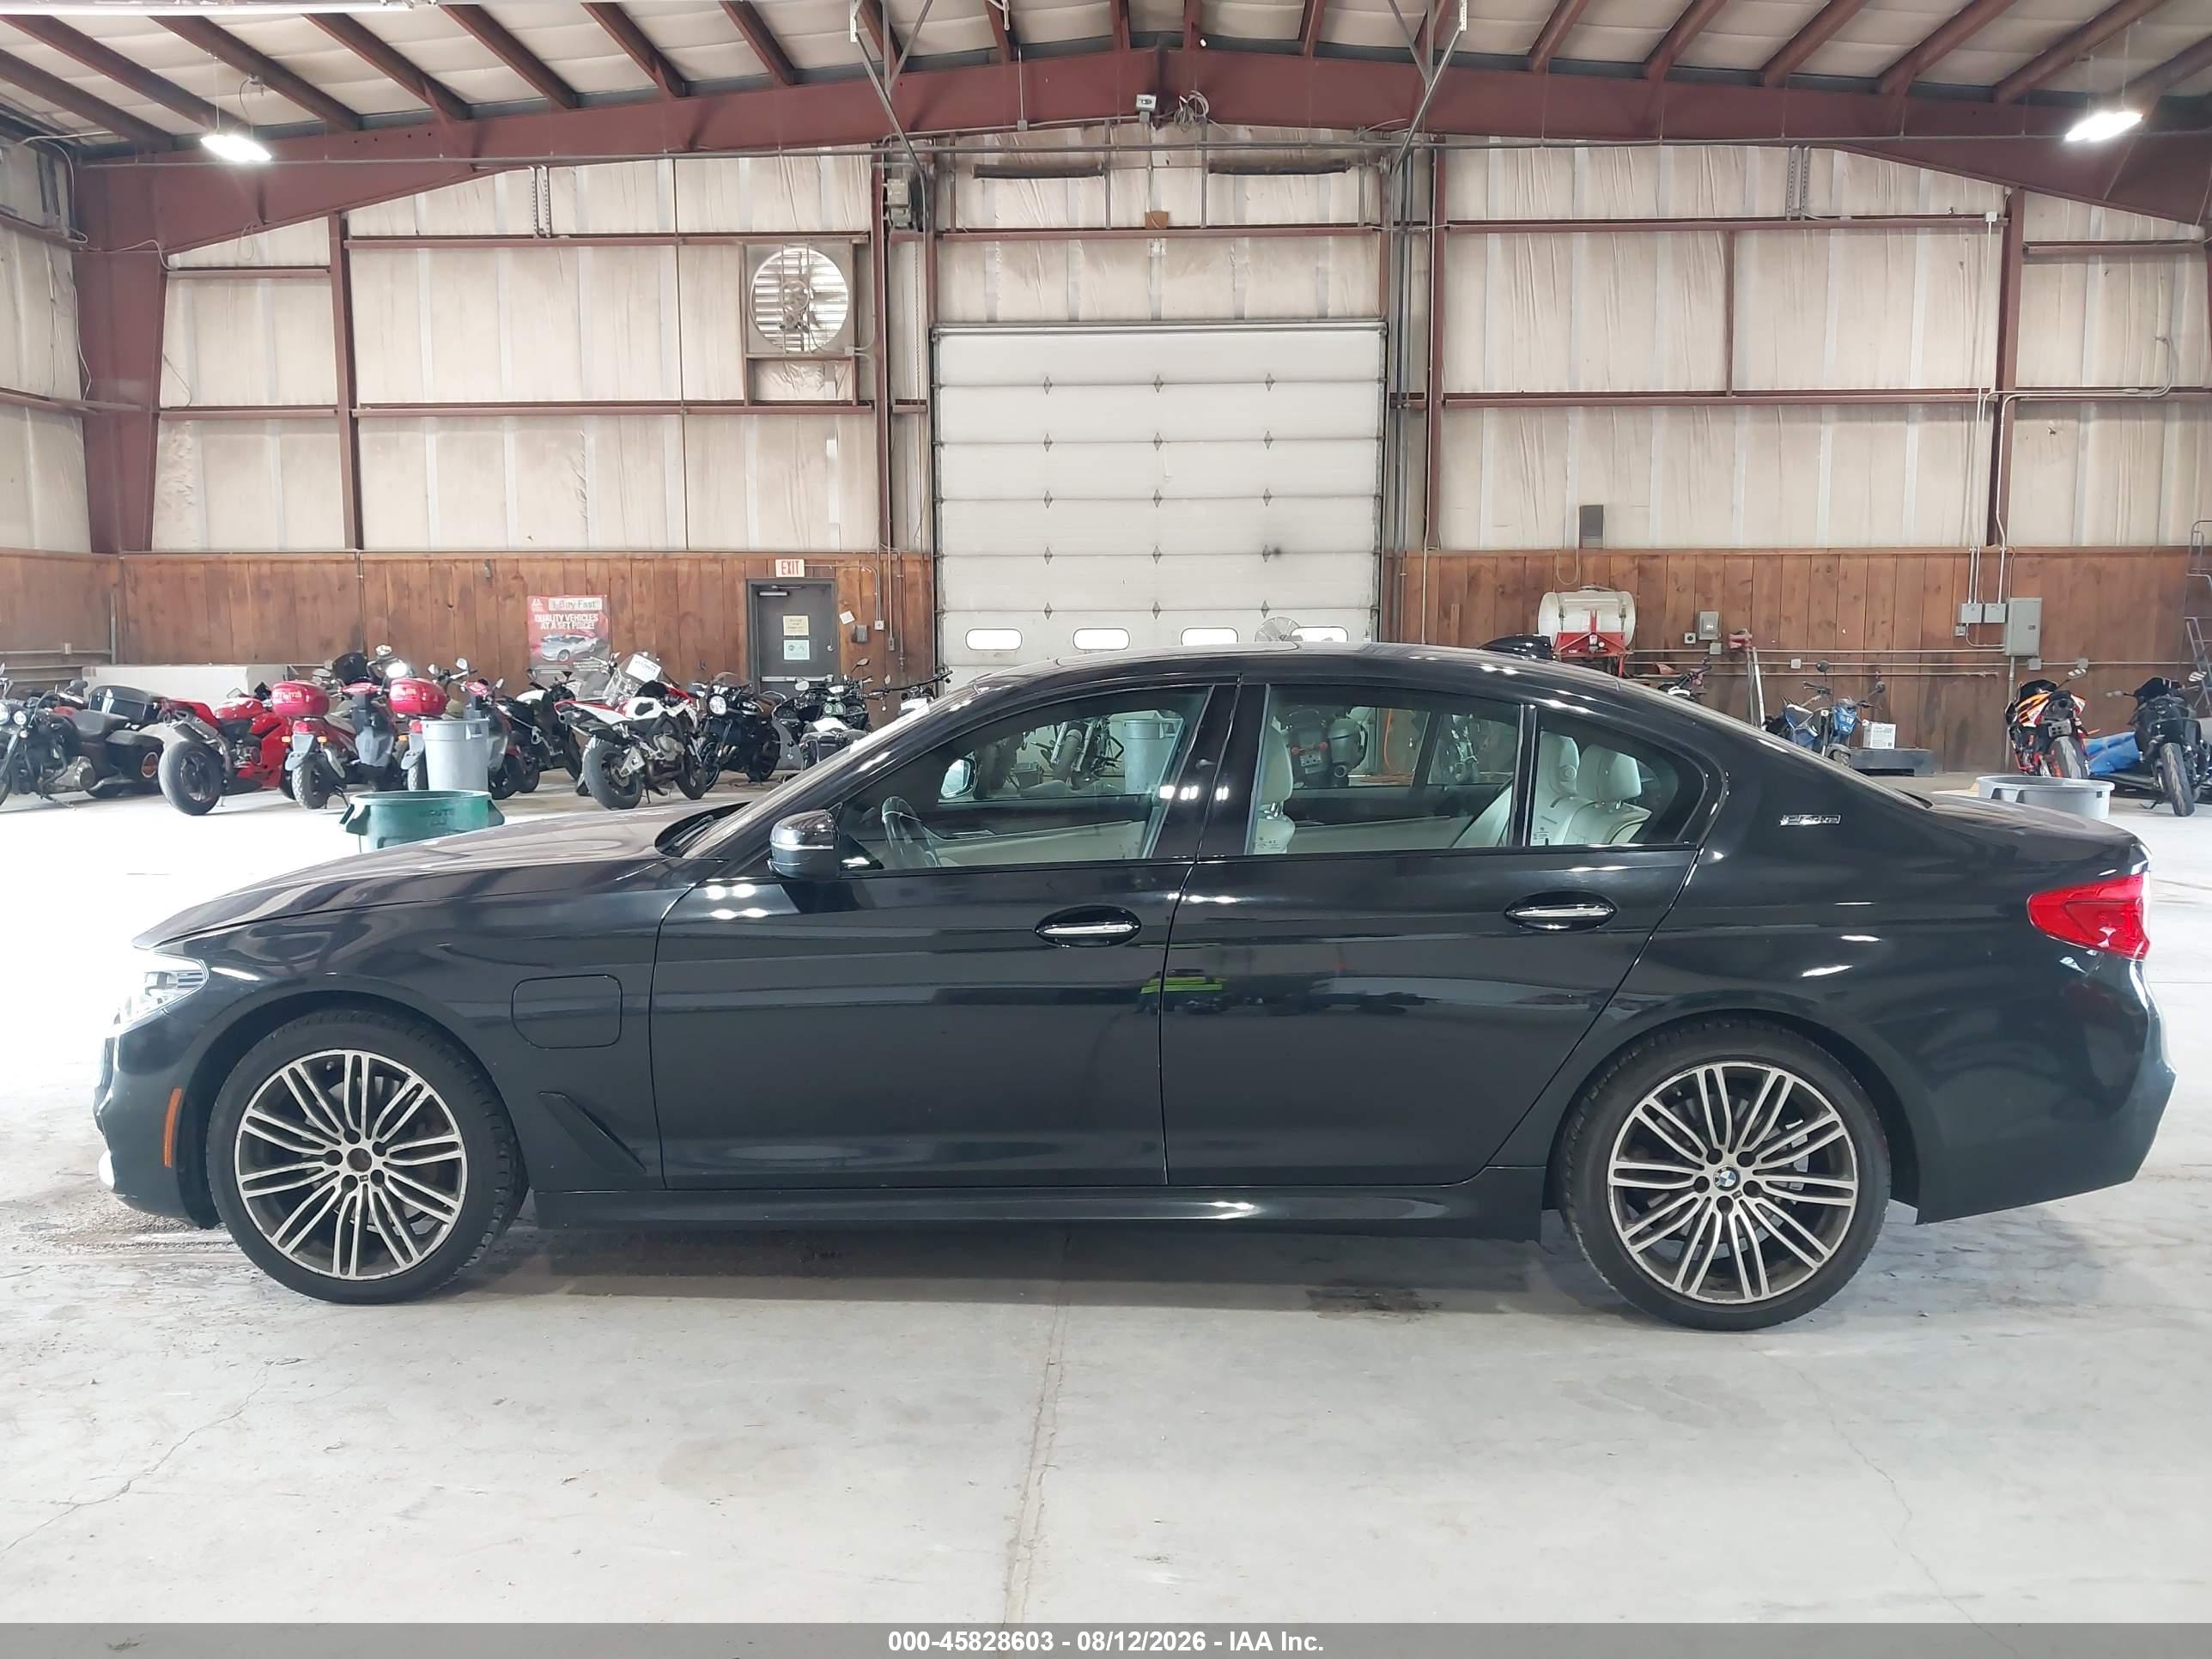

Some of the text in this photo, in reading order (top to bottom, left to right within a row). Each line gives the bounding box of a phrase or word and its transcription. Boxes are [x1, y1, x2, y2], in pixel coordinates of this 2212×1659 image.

[781, 561, 799, 574] EXIT
[578, 599, 596, 609] Fast
[535, 614, 599, 623] QUALITY VEHICLES
